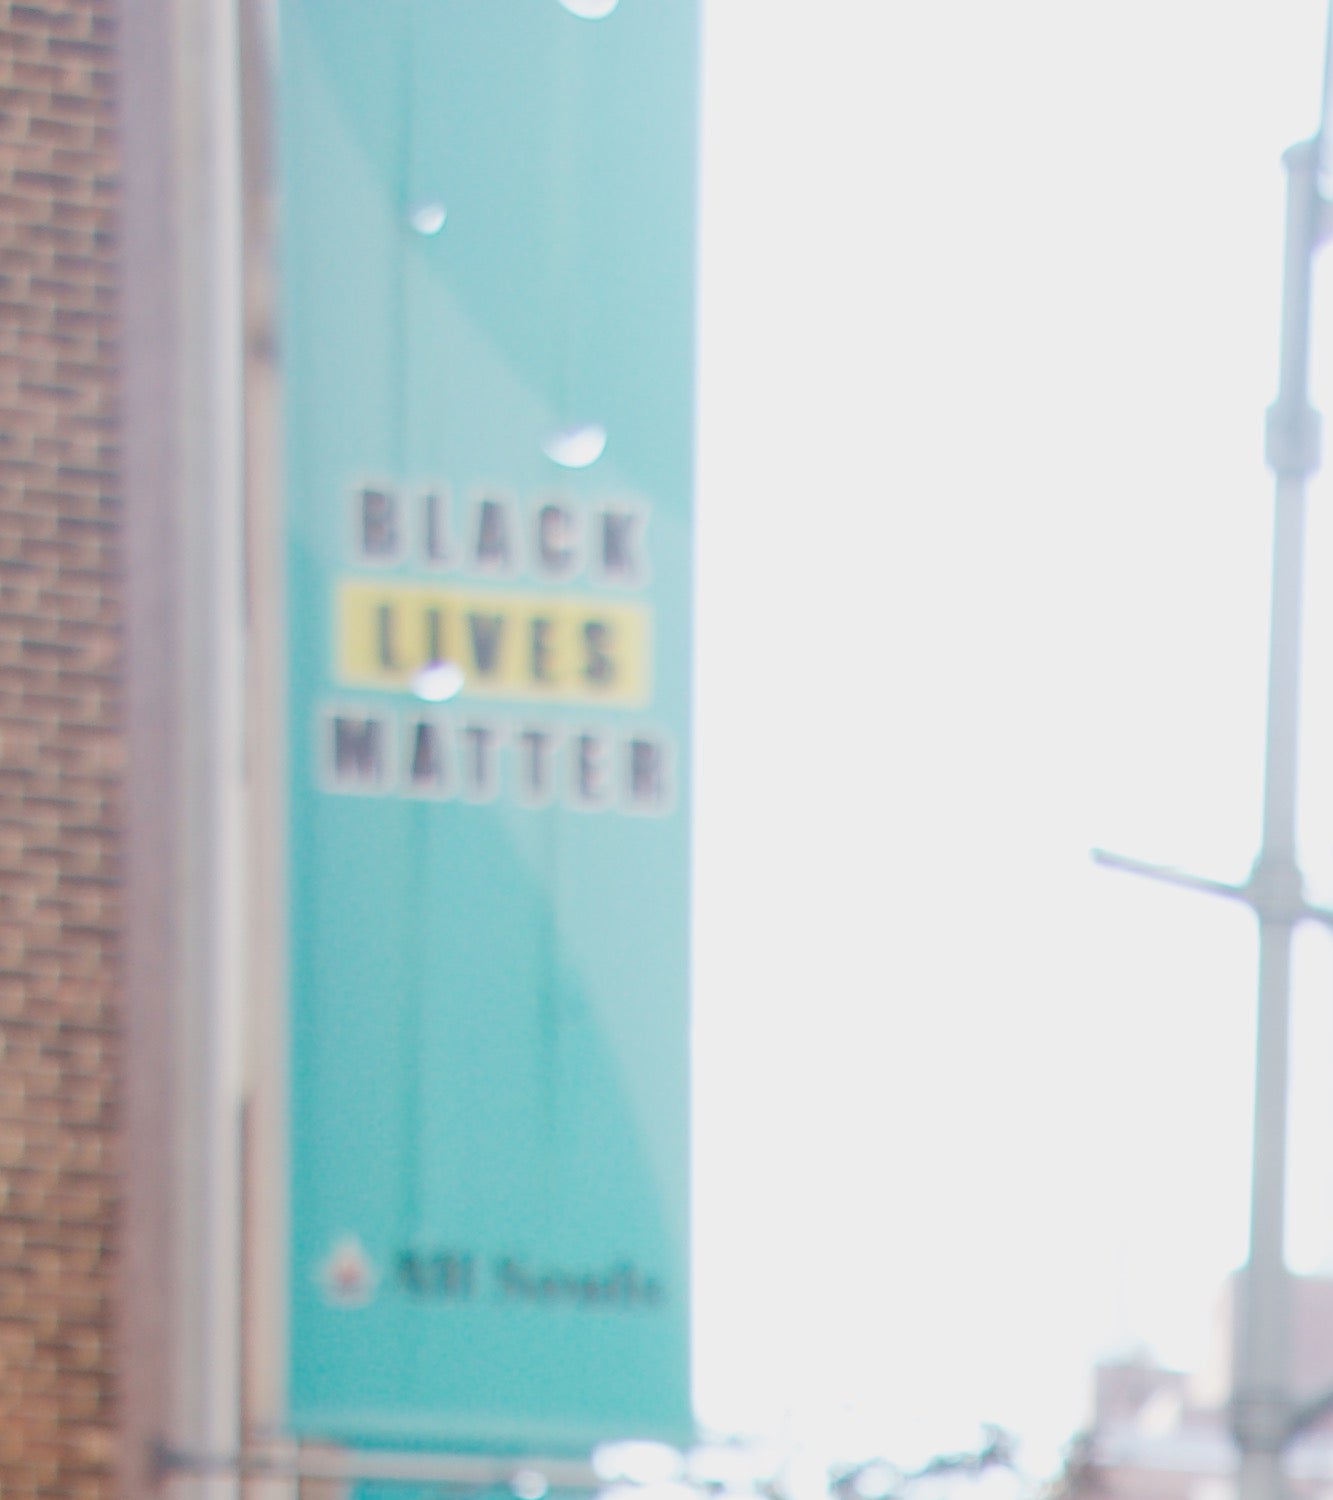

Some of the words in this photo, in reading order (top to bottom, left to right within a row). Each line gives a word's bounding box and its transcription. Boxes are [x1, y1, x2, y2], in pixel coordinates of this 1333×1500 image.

[360, 487, 638, 575] BLACK
[375, 602, 621, 690] LIVES
[332, 714, 666, 806] MATTER
